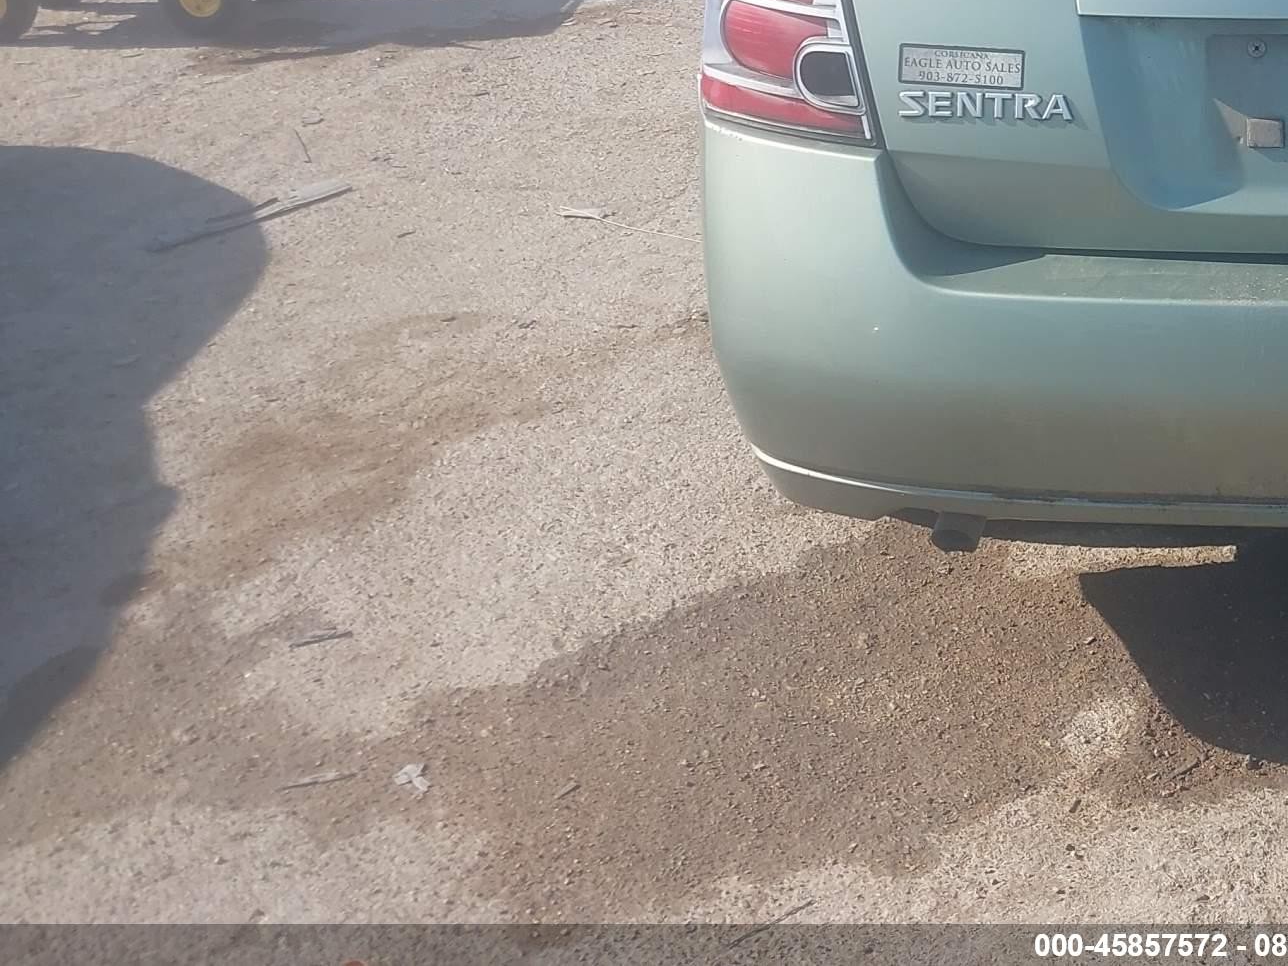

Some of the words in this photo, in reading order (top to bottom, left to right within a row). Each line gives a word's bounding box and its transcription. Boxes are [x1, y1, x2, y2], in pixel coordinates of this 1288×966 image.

[934, 50, 989, 59] CORSICANA
[904, 57, 943, 69] EAGLE
[945, 59, 981, 71] AUTO
[985, 61, 1021, 74] SALES
[918, 70, 1004, 85] 903-872-5100
[898, 91, 1073, 120] SENTRA
